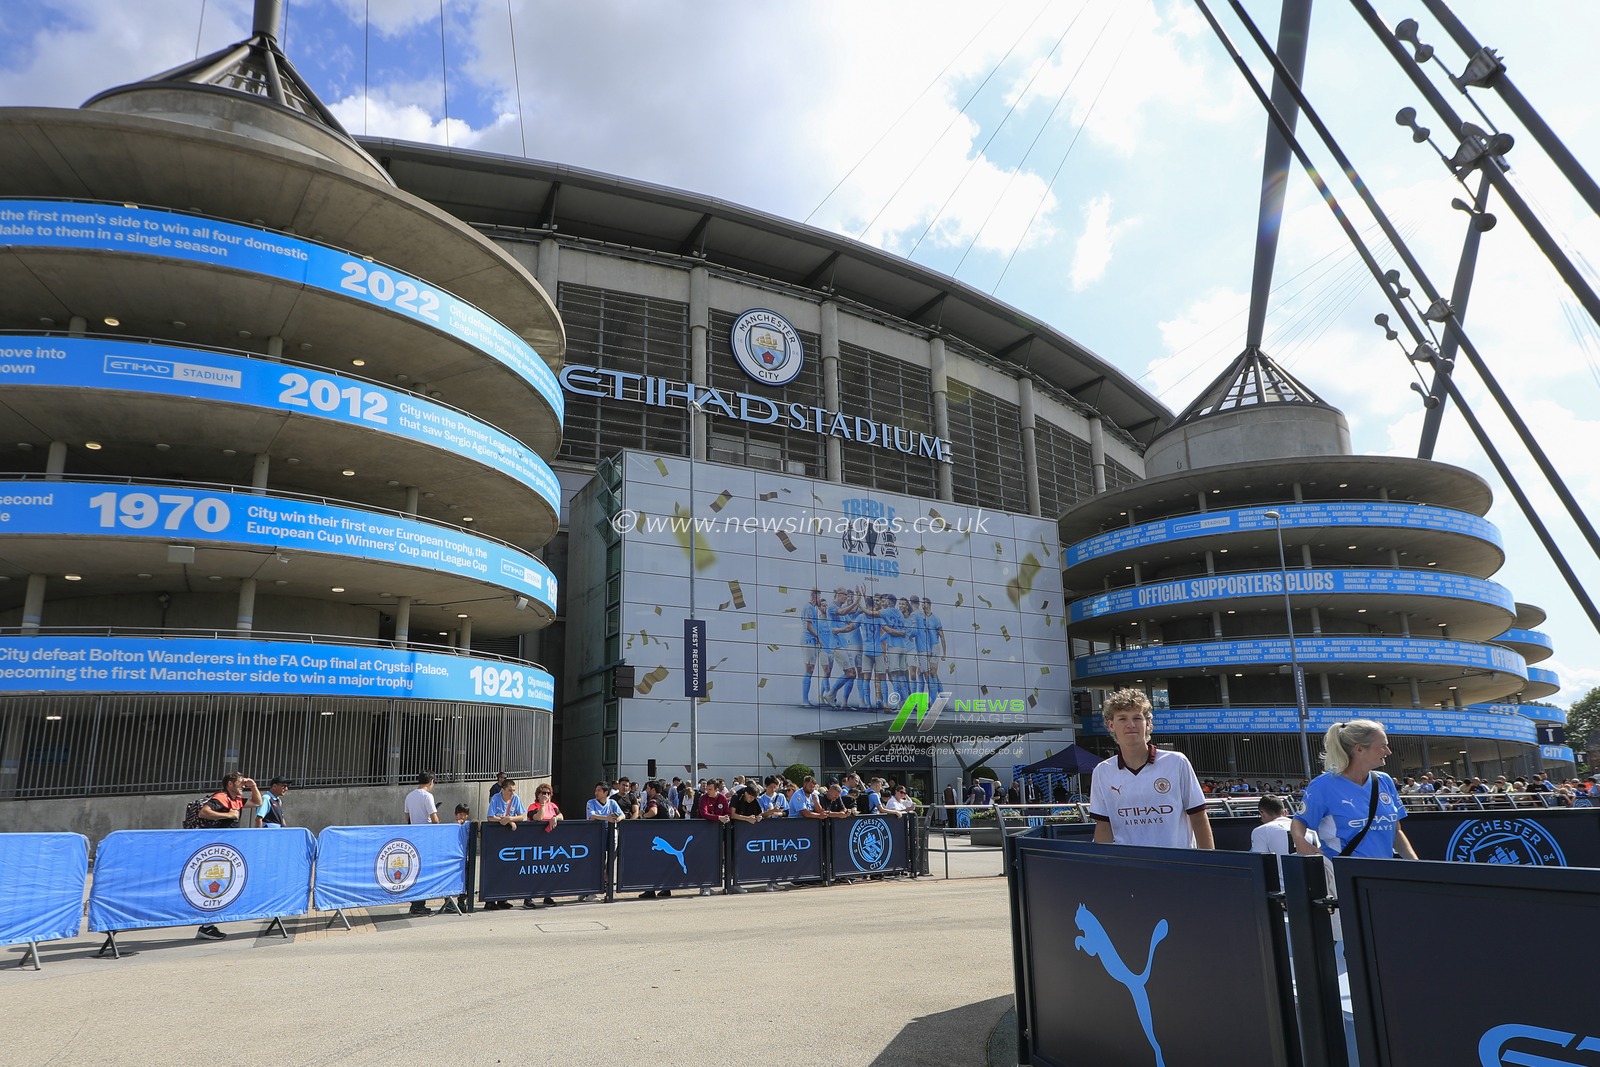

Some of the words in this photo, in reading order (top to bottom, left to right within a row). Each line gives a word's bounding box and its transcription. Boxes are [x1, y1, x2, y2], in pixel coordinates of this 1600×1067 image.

[0, 210, 24, 221] the
[28, 210, 58, 222] first
[61, 213, 106, 225] men's
[110, 215, 140, 229] side
[143, 219, 159, 231] to
[162, 221, 189, 235] win
[193, 225, 209, 239] all
[212, 230, 242, 245] four
[244, 237, 308, 261] domestic
[37, 225, 52, 236] to
[55, 226, 94, 238] them
[97, 228, 110, 239] in
[114, 231, 124, 241] a
[126, 232, 171, 248] single
[174, 238, 228, 256] season
[340, 261, 440, 322] 2022
[449, 304, 467, 319] City
[468, 315, 492, 334] defeat
[493, 330, 511, 348] Aston
[739, 314, 796, 344] MANCHESTER
[36, 347, 66, 360] into
[449, 317, 479, 340] League
[480, 333, 494, 347] title
[494, 342, 522, 368] following
[0, 362, 35, 374] own
[110, 361, 170, 374] ETIHAD
[183, 368, 234, 383] STADIUM
[758, 370, 780, 381] CITY
[279, 373, 388, 424] 2012
[559, 365, 779, 424] ETIHAD
[789, 402, 943, 462] STADIUM
[399, 417, 420, 431] that
[423, 424, 442, 438] saw
[444, 431, 471, 449] Sergio
[472, 441, 498, 460] Agüero
[400, 403, 420, 419] City
[423, 409, 440, 423] win
[441, 415, 456, 430] the
[458, 421, 488, 443] Premier
[489, 436, 512, 454] League
[90, 492, 230, 532] 1970
[842, 498, 896, 529] TREBLE
[247, 506, 277, 522] City
[280, 512, 305, 524] win
[308, 514, 339, 528] their
[341, 519, 366, 532] first
[369, 527, 394, 538] ever
[396, 528, 443, 547] European
[444, 538, 474, 557] trophy,
[475, 547, 488, 559] the
[1175, 523, 1199, 531] ETIHAD
[1204, 518, 1227, 526] STADIUM
[247, 522, 314, 539] European
[317, 530, 343, 545] Cup
[345, 534, 397, 552] Winners'
[398, 543, 420, 557] Cup
[421, 548, 438, 560] and
[441, 552, 471, 568] League
[472, 560, 487, 573] Cup
[503, 564, 524, 577] ETIHAD
[843, 554, 899, 578] WINNERS
[1138, 583, 1189, 606] OFFICIAL
[1191, 574, 1282, 599] SUPPORTERS
[1286, 572, 1334, 591] CLUBS
[0, 648, 29, 663] City
[32, 648, 86, 661] defeat
[89, 648, 144, 662] Bolton
[148, 650, 234, 665] Wanderers
[237, 653, 250, 665] in
[253, 653, 277, 666] the
[280, 654, 298, 667] FA
[301, 655, 328, 671] Cup
[330, 656, 358, 670] final
[359, 659, 371, 671] at
[374, 660, 413, 675] Crystal
[415, 662, 449, 677] Palace,
[80, 667, 108, 679] the
[111, 667, 146, 680] first
[150, 668, 245, 682] Manchester
[250, 670, 281, 682] side
[283, 672, 298, 683] to
[300, 672, 326, 684] win
[328, 676, 337, 684] a
[339, 674, 374, 688] major
[376, 676, 413, 690] trophy
[470, 666, 524, 699] 1923
[840, 742, 866, 751] COLIN
[1546, 728, 1554, 742] T
[869, 754, 915, 763] RECEPTION
[1543, 746, 1563, 758] CITY
[1118, 804, 1173, 817] ETIHAD
[1125, 817, 1164, 825] AIRWAYS
[380, 843, 416, 860] MANCHESTER
[498, 844, 589, 861] ETIHAD
[746, 838, 811, 852] ETIHAD
[853, 819, 885, 843] MANCHESTER
[870, 860, 882, 869] CITY
[1456, 820, 1542, 862] MANCHESTER
[190, 848, 242, 869] MANCHESTER
[519, 863, 570, 875] AIRWAYS
[761, 854, 798, 863] AIRWAYS
[1543, 853, 1555, 862] 94
[203, 899, 222, 907] CITY
